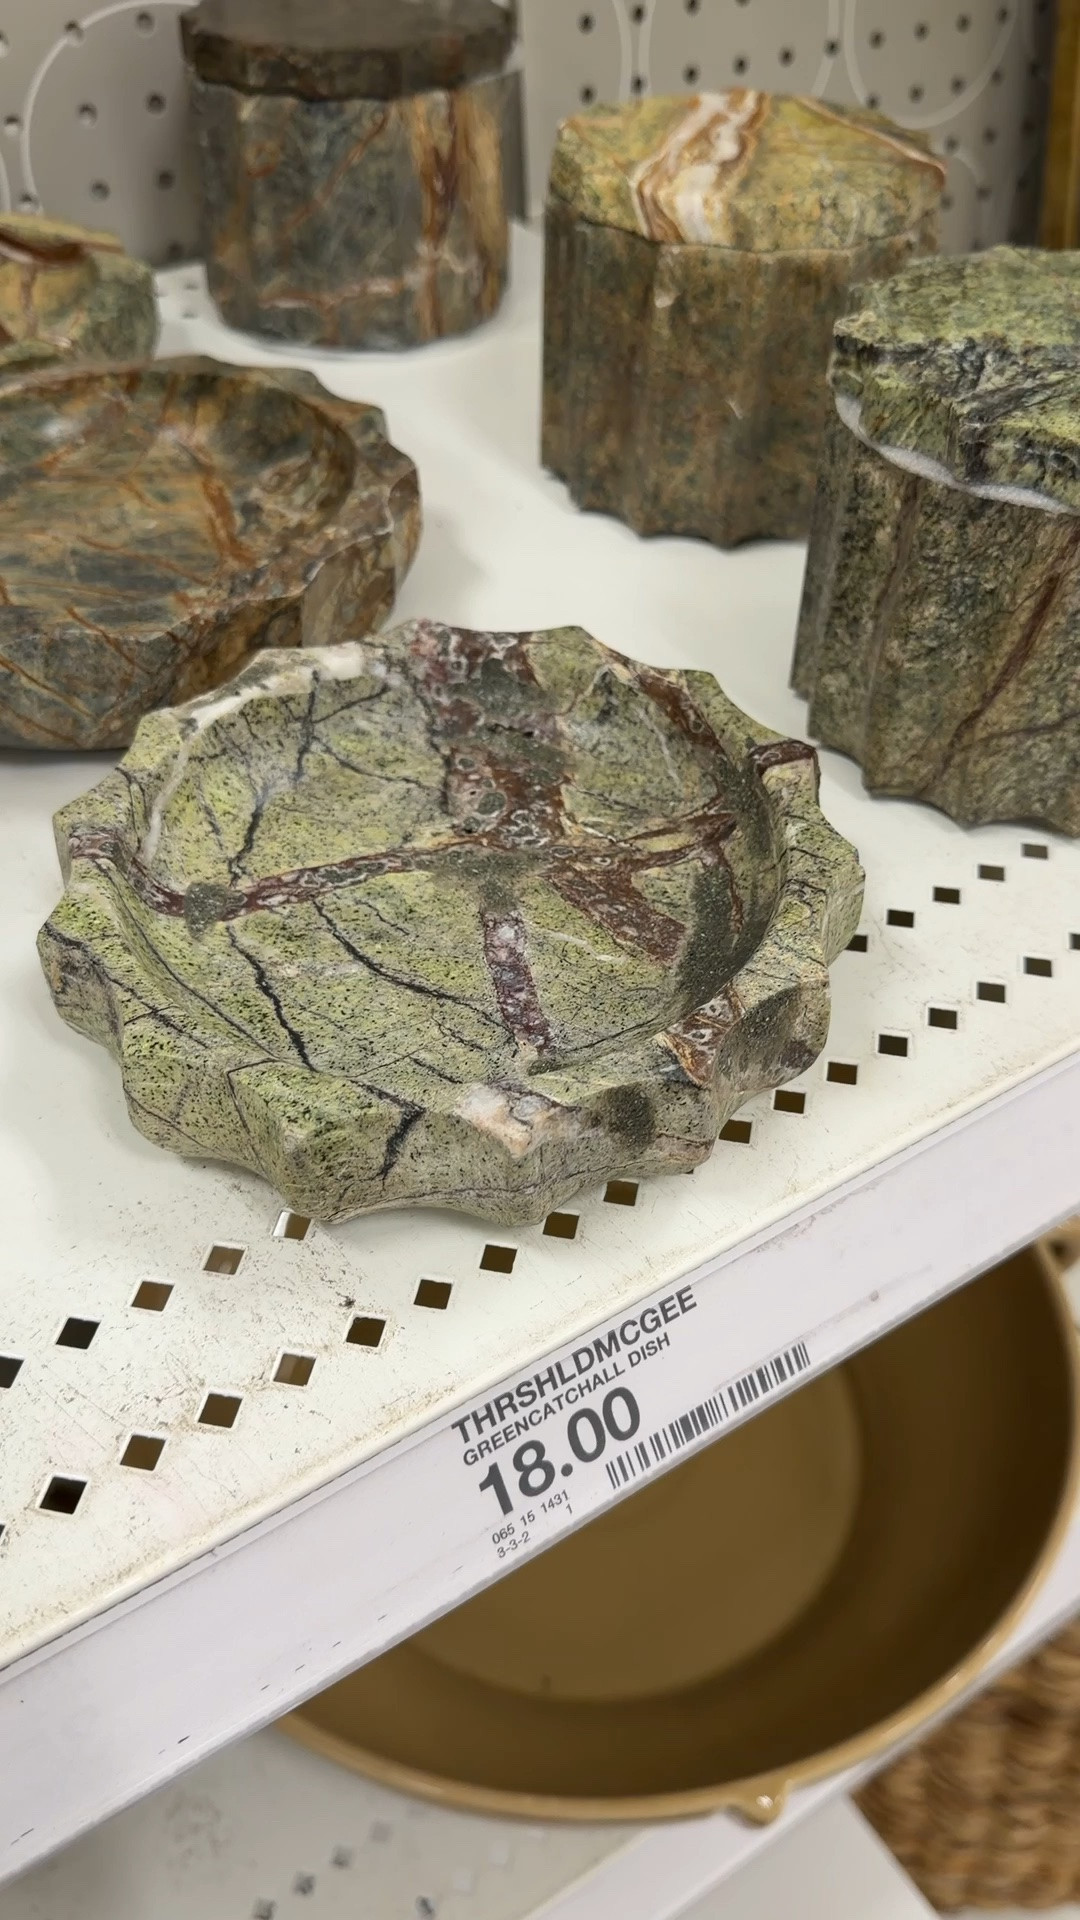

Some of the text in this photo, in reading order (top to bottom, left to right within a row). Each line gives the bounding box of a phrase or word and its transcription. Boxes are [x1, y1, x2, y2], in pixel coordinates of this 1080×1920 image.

[451, 1285, 697, 1444] THRSHLDMCGEE
[463, 1332, 670, 1466] GREENCATCHALL DISH
[479, 1386, 640, 1516] 18.00
[492, 1489, 569, 1545] 065 15 1431
[497, 1531, 531, 1558] 3-3-2
